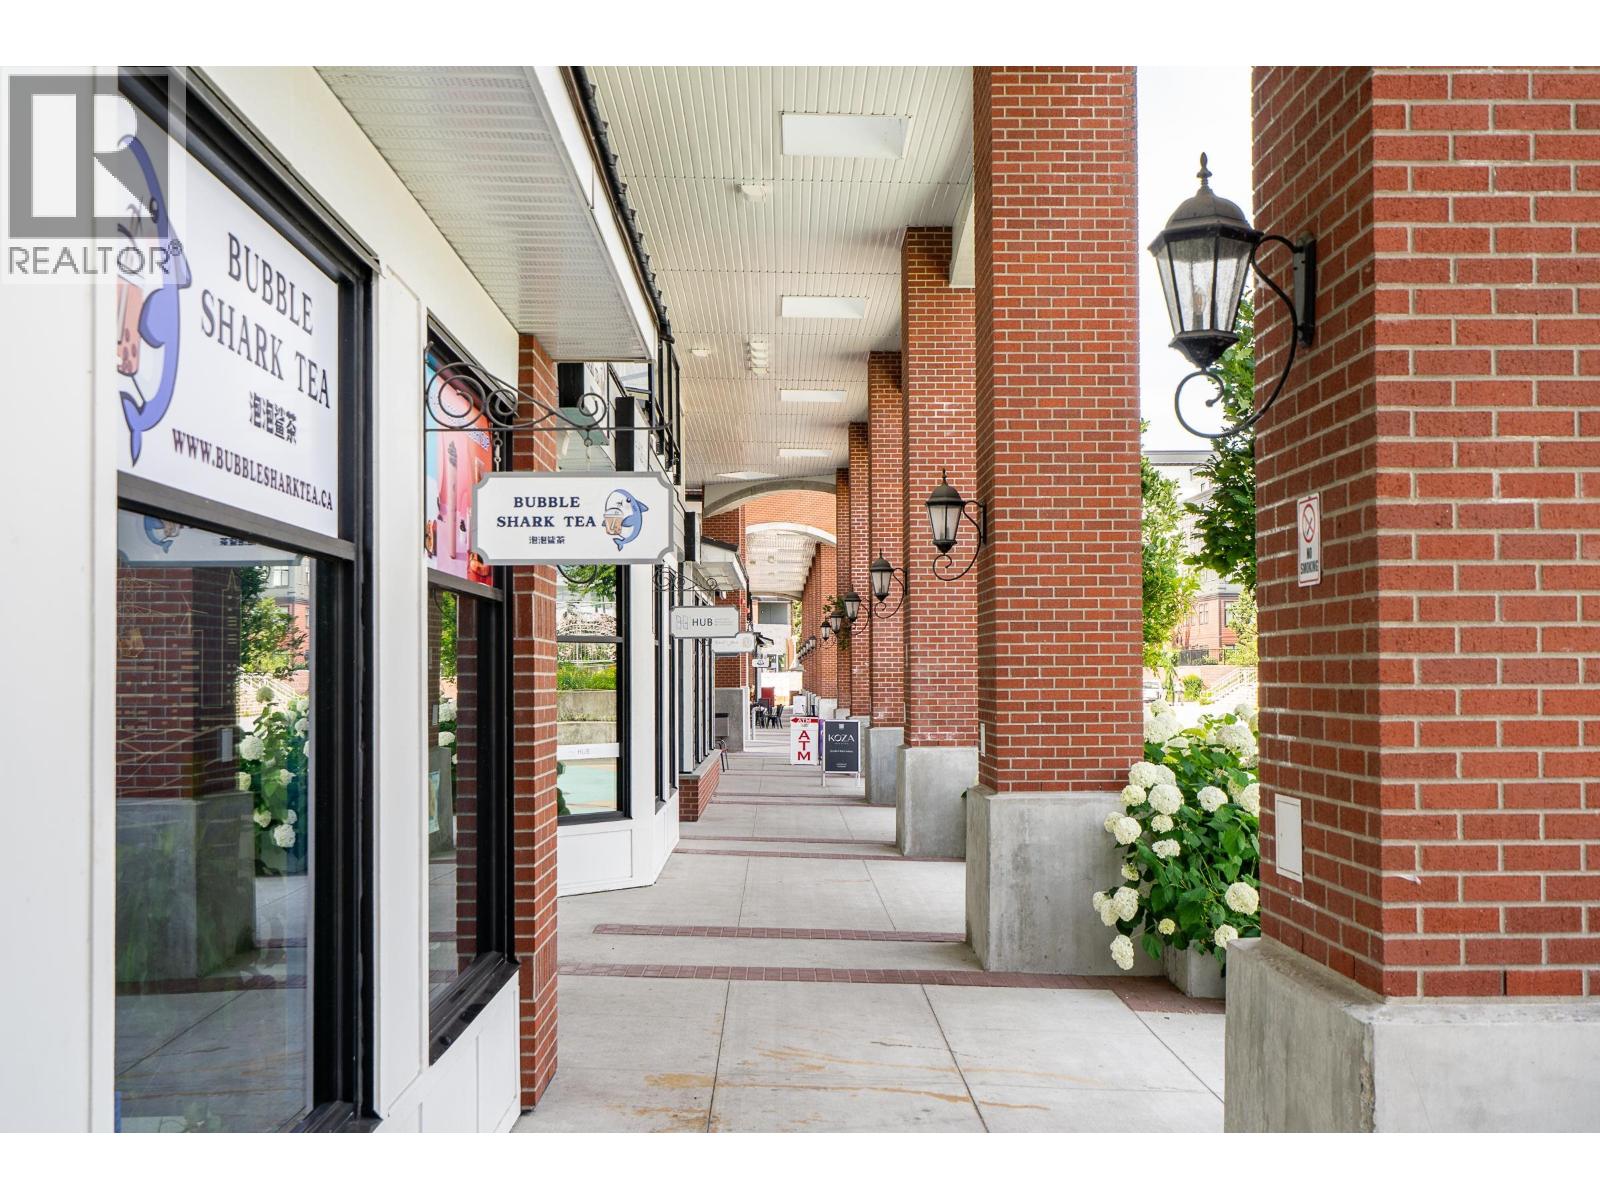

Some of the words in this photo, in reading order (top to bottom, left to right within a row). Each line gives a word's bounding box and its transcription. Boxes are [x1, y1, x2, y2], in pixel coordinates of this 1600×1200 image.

[228, 231, 314, 336] BUBBLE
[201, 288, 285, 382] SHARK
[295, 351, 331, 409] TEA
[172, 428, 334, 511] WWW.BUBBLESHARKTEA.CA
[513, 496, 581, 508] BUBBLE
[496, 516, 555, 528] SHARK
[564, 516, 596, 528] TEA
[1306, 547, 1313, 559] NO
[1300, 560, 1319, 575] SMOKING
[691, 617, 713, 627] HUB
[828, 734, 855, 742] KOZA
[797, 730, 811, 761] ATM
